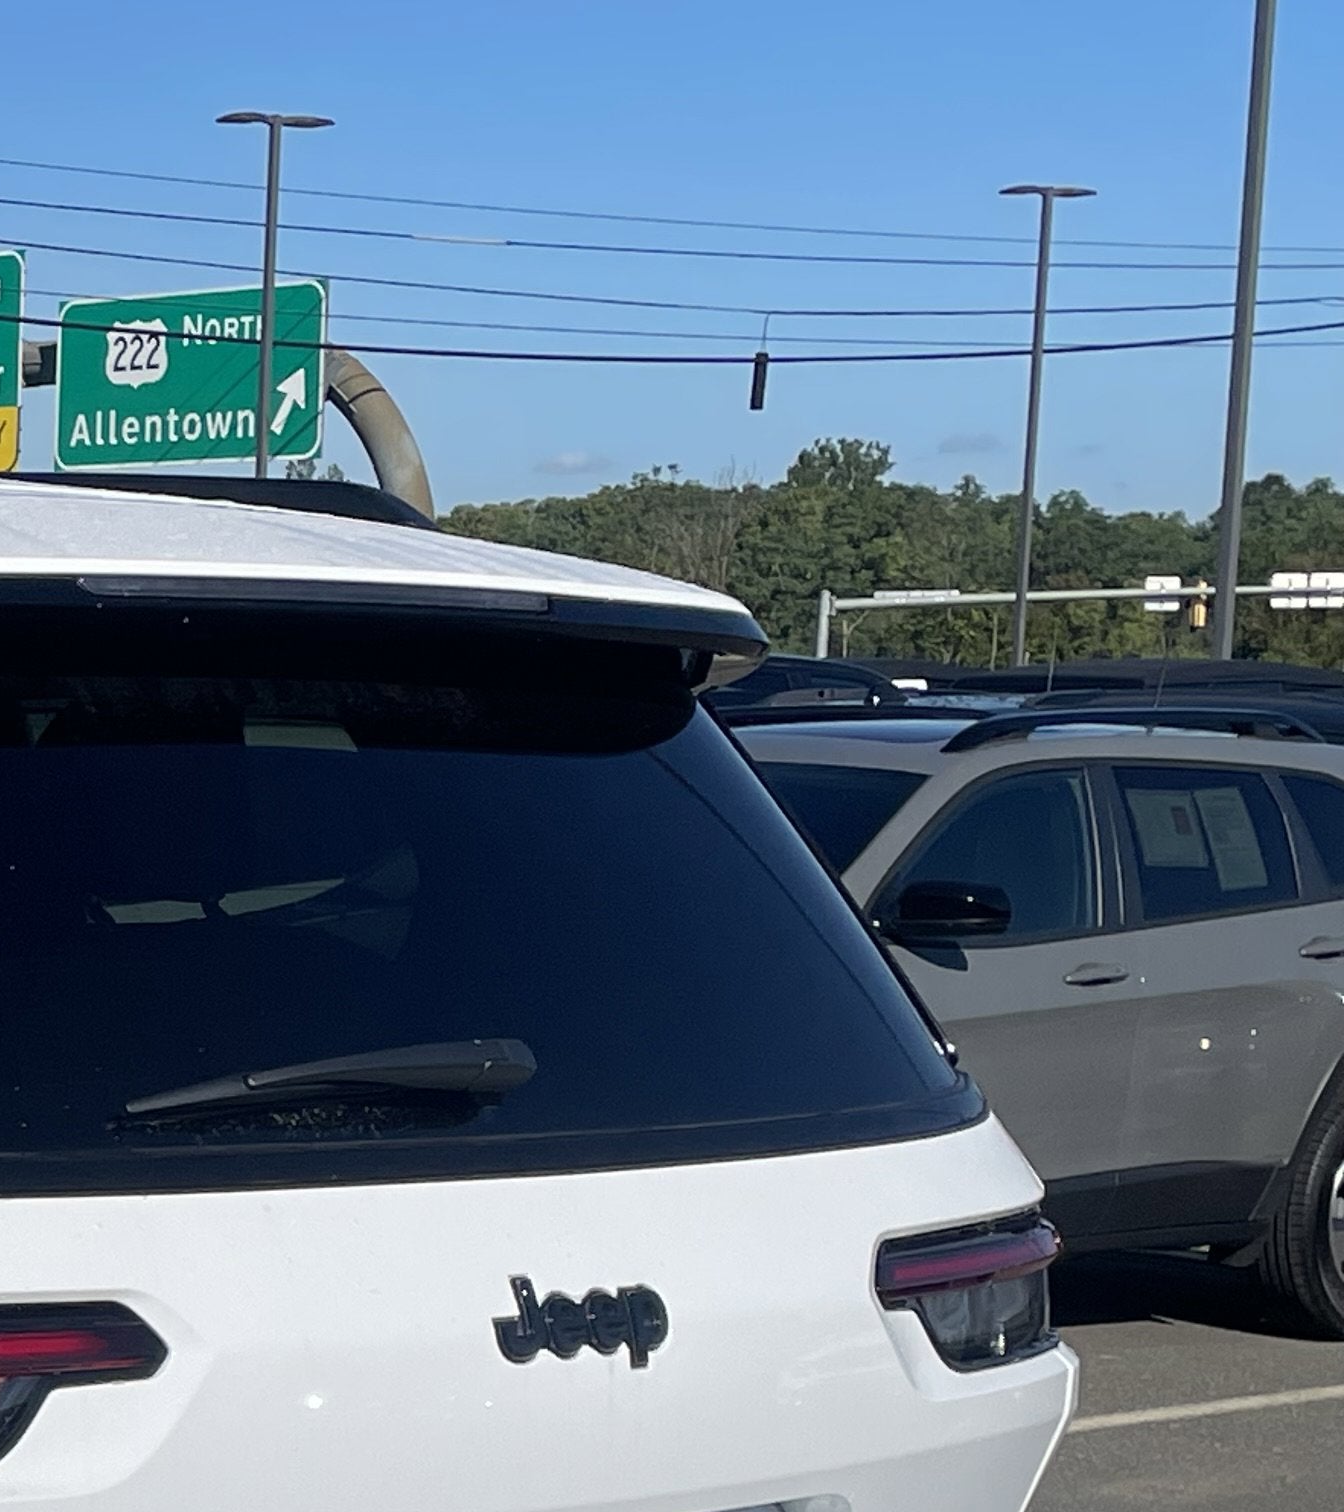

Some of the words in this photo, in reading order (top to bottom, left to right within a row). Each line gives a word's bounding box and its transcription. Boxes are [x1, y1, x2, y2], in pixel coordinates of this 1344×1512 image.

[113, 335, 160, 372] 222
[70, 408, 255, 447] Allentown
[492, 1275, 668, 1369] Jeep
